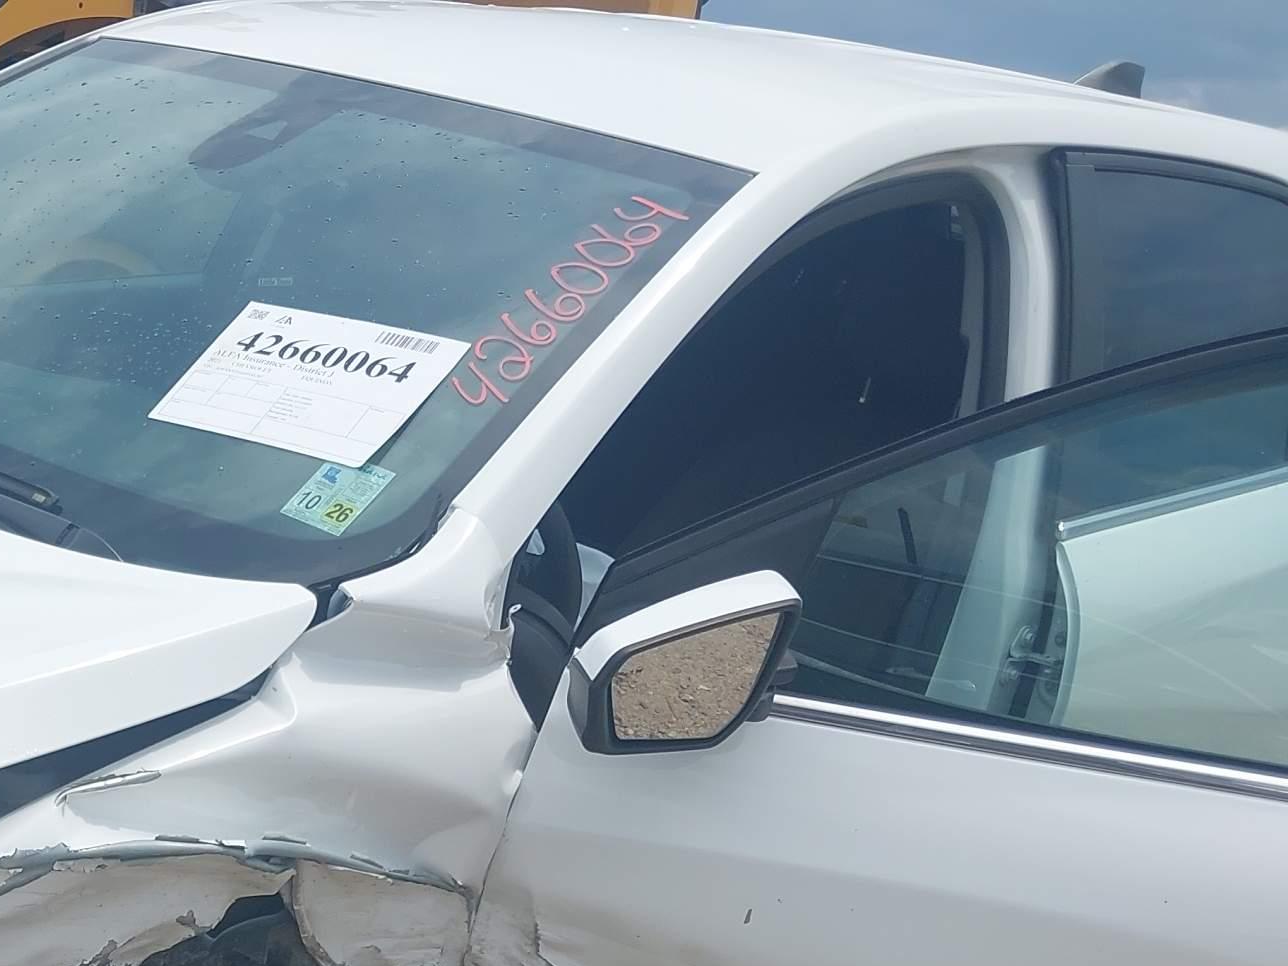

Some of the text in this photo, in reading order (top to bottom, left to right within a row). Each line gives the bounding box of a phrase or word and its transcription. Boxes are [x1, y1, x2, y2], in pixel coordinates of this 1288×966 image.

[451, 195, 691, 406] 42660064
[236, 331, 418, 384] 42660064
[242, 353, 286, 368] Insurance
[292, 364, 327, 377] District
[296, 491, 322, 510] 10
[324, 503, 354, 523] 26
